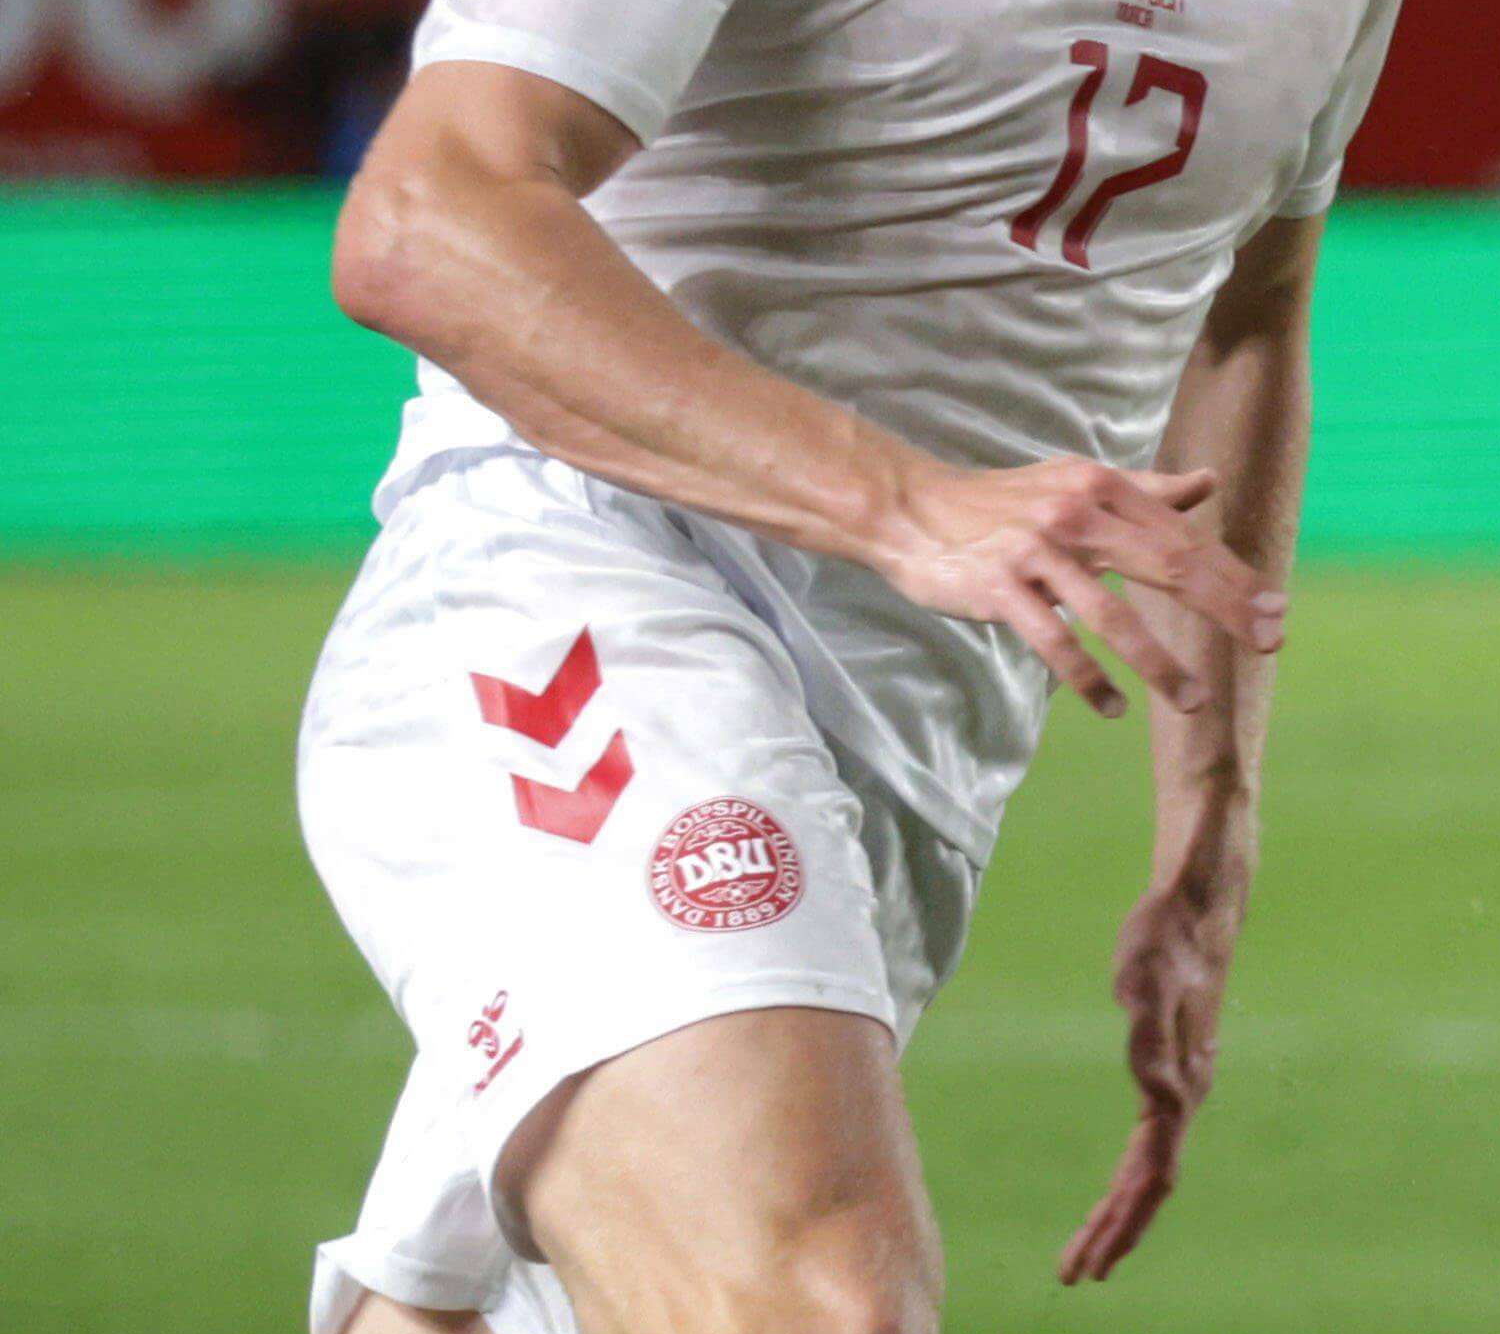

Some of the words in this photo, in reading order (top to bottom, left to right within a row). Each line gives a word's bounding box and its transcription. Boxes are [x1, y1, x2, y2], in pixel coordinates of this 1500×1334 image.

[1009, 39, 1209, 271] 17
[652, 858, 704, 925] DANSK
[771, 832, 800, 902] UNION
[674, 837, 777, 893] DBU
[714, 901, 776, 927] 1889
